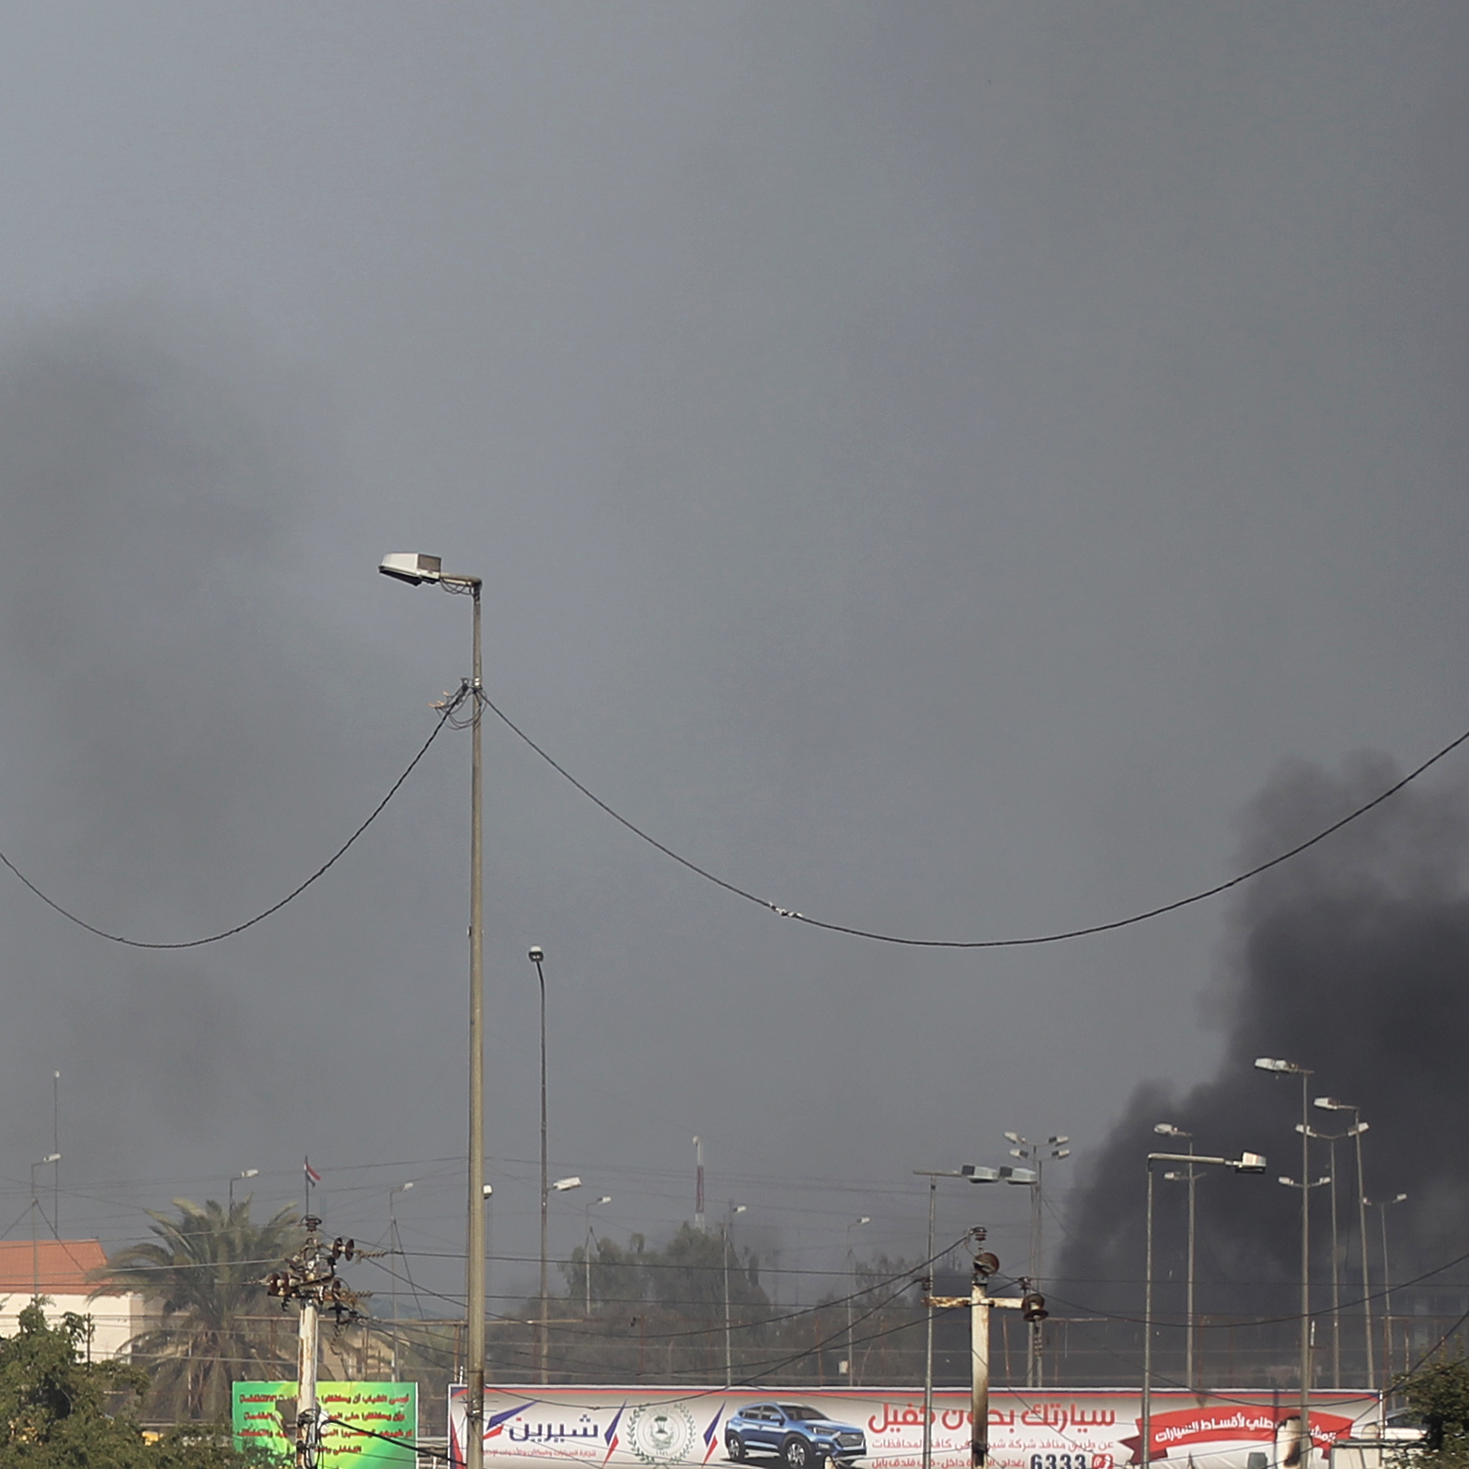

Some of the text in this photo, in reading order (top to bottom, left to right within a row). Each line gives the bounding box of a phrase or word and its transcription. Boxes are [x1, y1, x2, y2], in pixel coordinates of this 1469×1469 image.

[941, 1408, 1015, 1433] بدن
[1021, 1403, 1116, 1433] سيارتك
[509, 1414, 599, 1442] شيرين
[872, 1438, 922, 1450] لمحافظات
[1009, 1438, 1037, 1452] شركة
[1098, 1441, 1115, 1452] عن
[1001, 1458, 1025, 1469] بغداد
